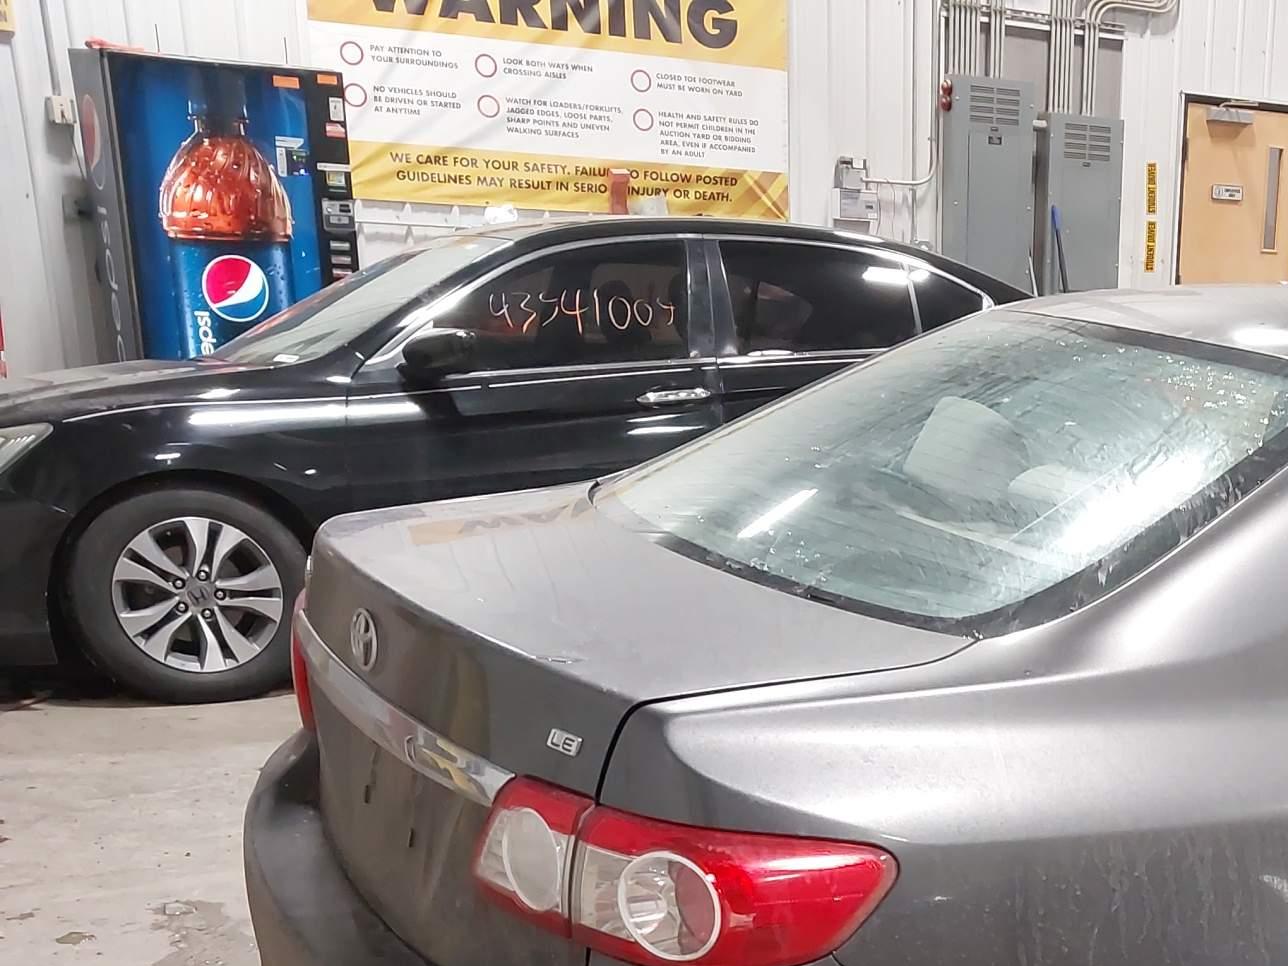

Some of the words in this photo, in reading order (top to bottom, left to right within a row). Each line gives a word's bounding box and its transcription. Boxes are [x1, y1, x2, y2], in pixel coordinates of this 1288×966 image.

[370, 44, 384, 52] PAY
[388, 46, 430, 56] ATTENTION
[371, 55, 393, 63] YOUR
[396, 57, 459, 69] SURROUNDINGS
[502, 57, 523, 66] LOOK
[525, 60, 546, 68] BOTH
[548, 62, 569, 70] WAYS
[571, 64, 593, 72] WHEN
[503, 67, 542, 77] CROSSING
[544, 71, 567, 79] AISLES
[656, 73, 682, 81] CLOSED
[698, 77, 735, 87] FOOTWEAR
[656, 82, 676, 90] MUST
[388, 87, 423, 96] VEHICLES
[425, 90, 457, 98] SHOULD
[384, 96, 414, 104] DRIVEN
[430, 101, 461, 109] STARTED
[505, 96, 532, 105] WATCH
[533, 99, 548, 107] FOR
[386, 107, 421, 115] ANYTIME
[506, 107, 535, 115] JAGGED
[563, 112, 587, 120] LOOSE
[506, 116, 531, 124] SHARP
[532, 119, 560, 127] POINTS
[561, 121, 578, 129] AND
[580, 123, 610, 132] UNEVEN
[658, 111, 684, 119] HEALTH
[703, 115, 727, 123] SAFETY
[728, 117, 748, 125] RULES
[506, 126, 542, 136] WALKING
[544, 129, 580, 139] SURFACES
[658, 120, 674, 128] NOT
[675, 122, 700, 130] PERMIT
[701, 124, 734, 133] CHILDREN
[659, 130, 690, 138] AUCTION
[692, 132, 710, 140] YARD
[724, 135, 751, 144] BIDDING
[684, 150, 705, 158] ADULT
[709, 143, 756, 153] ACCOMPANIED
[390, 152, 412, 164] WE
[416, 153, 449, 166] CARE
[453, 156, 479, 169] FOR
[482, 158, 519, 172] YOUR
[523, 161, 571, 176] SAFETY.
[643, 169, 692, 183] FOLLOW
[696, 174, 738, 187] POSTED
[396, 169, 472, 185] GUIDELINES
[476, 175, 505, 188] MAY
[510, 178, 555, 191] RESULT
[556, 180, 569, 192] IN
[627, 184, 669, 197] INJURY
[673, 188, 690, 199] OR
[694, 190, 733, 202] DEATH.
[194, 310, 217, 356] epsi
[549, 730, 578, 754] LE
